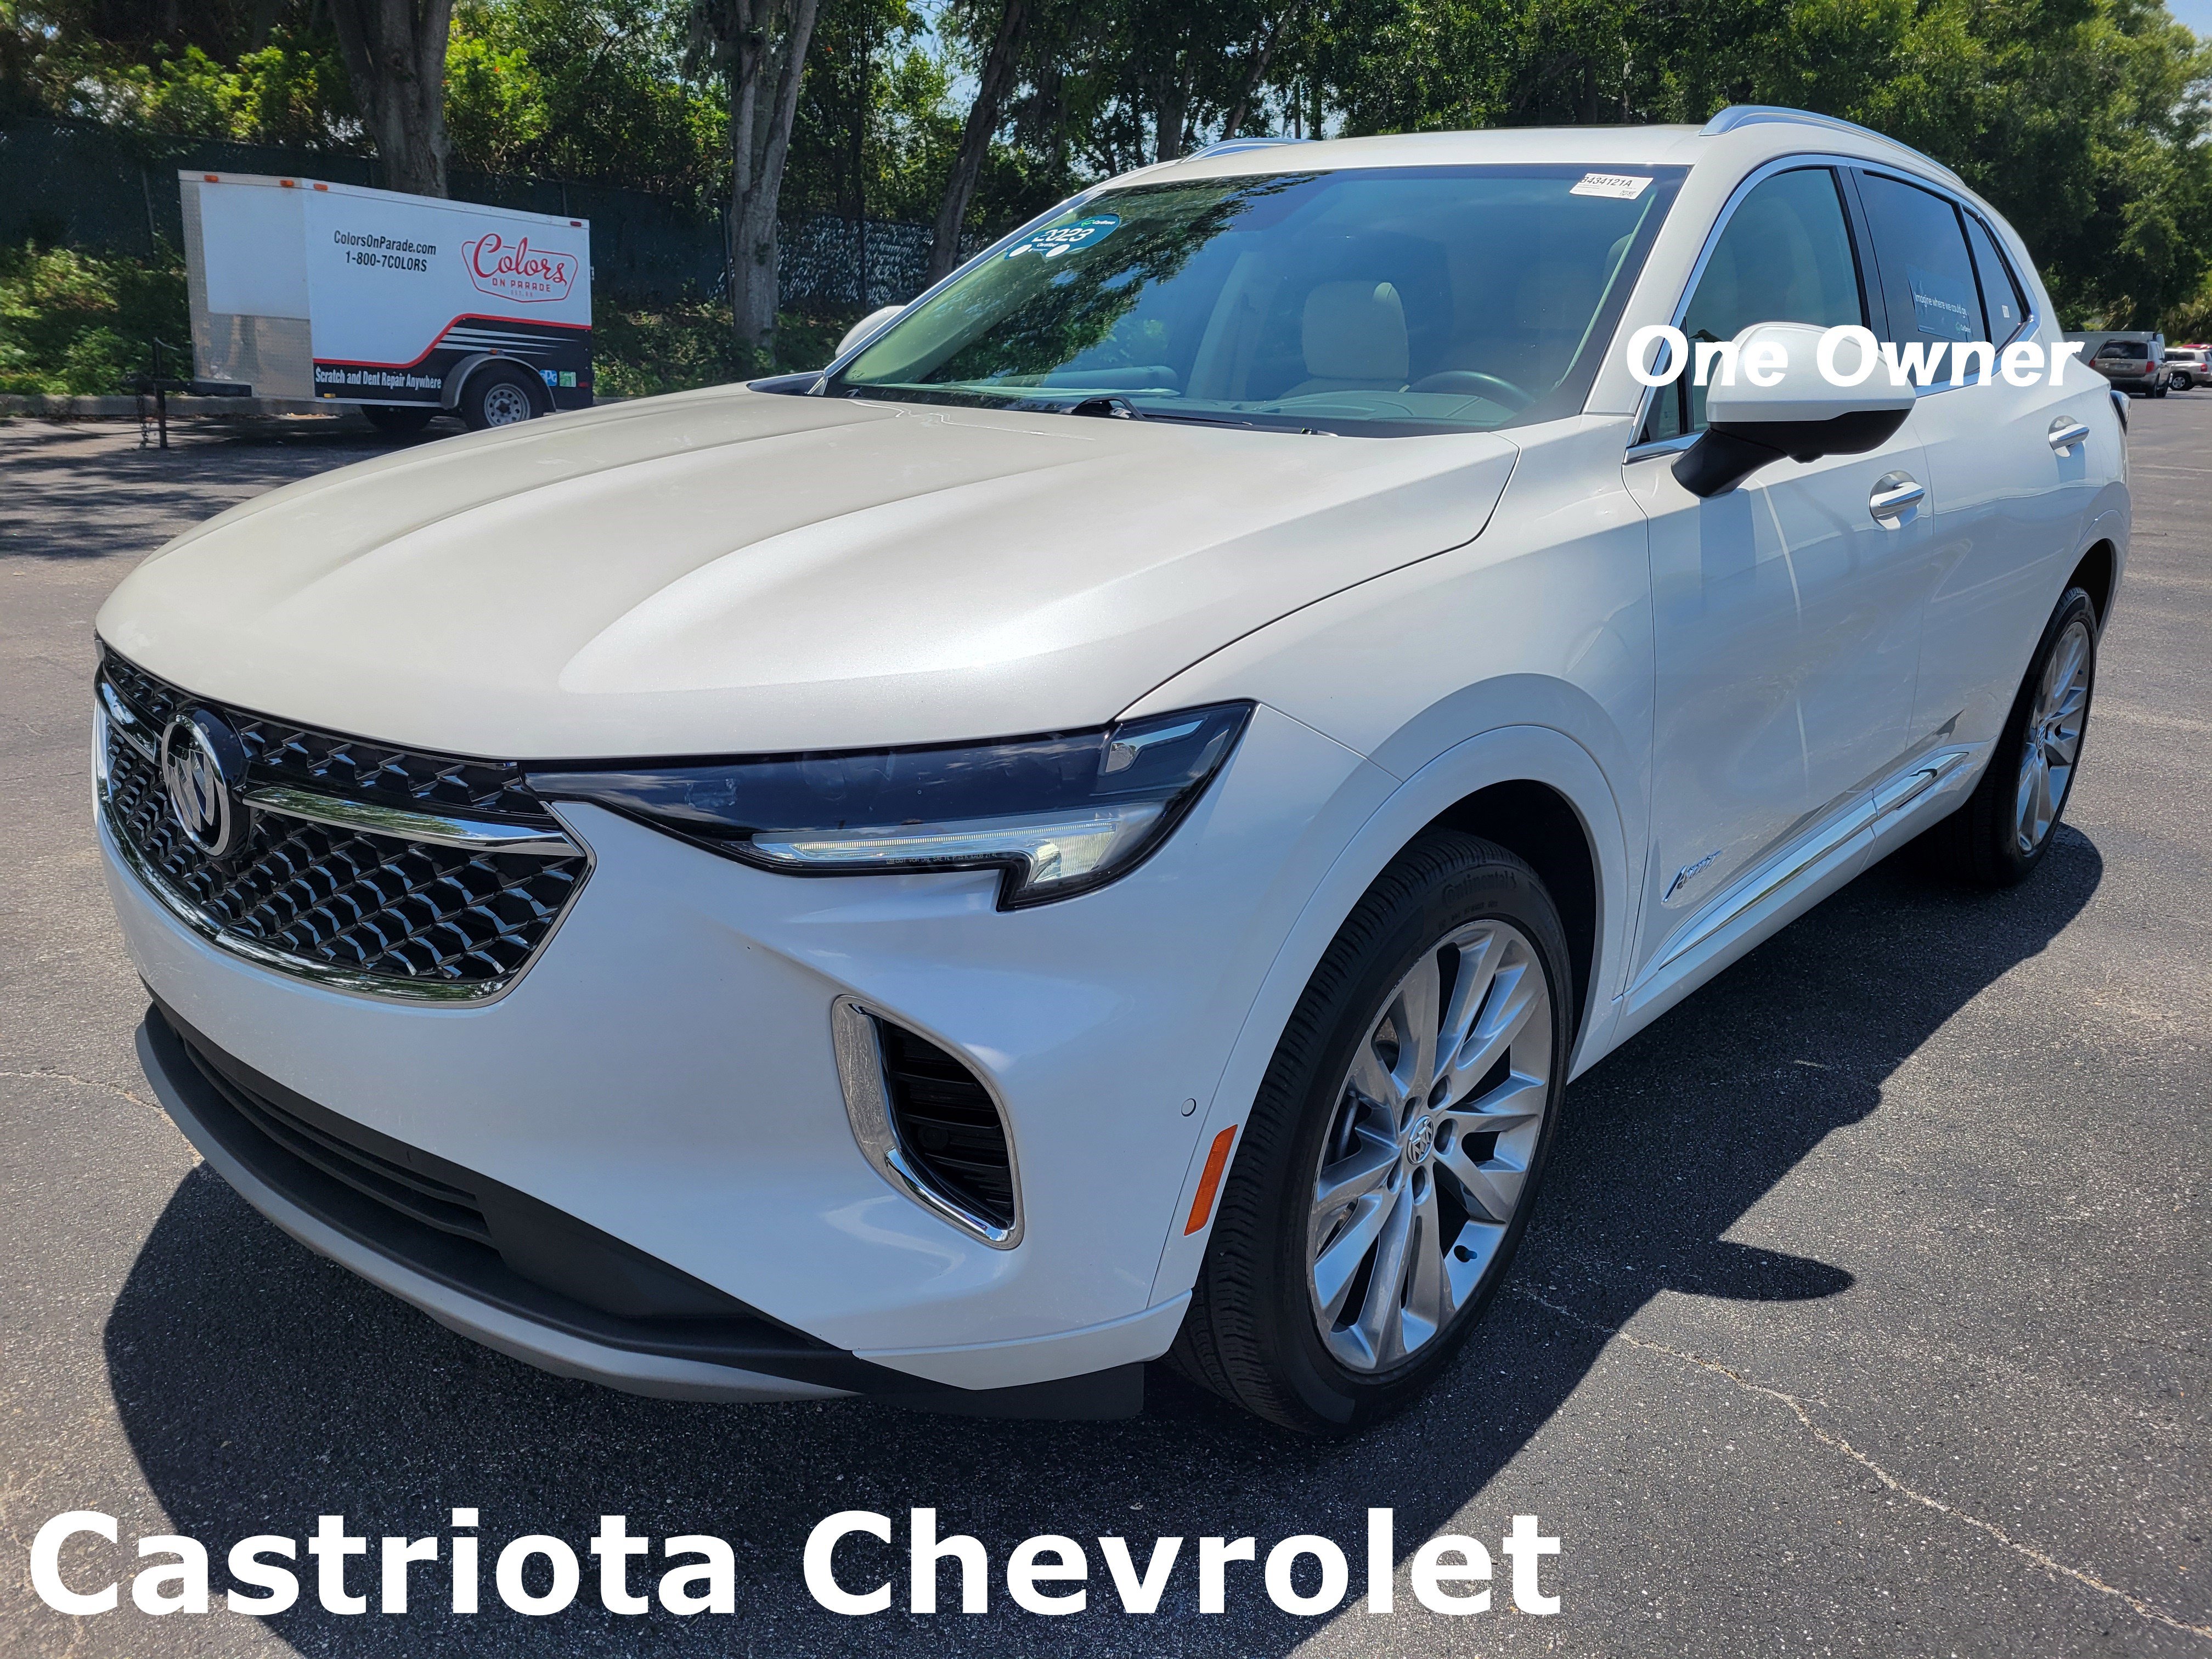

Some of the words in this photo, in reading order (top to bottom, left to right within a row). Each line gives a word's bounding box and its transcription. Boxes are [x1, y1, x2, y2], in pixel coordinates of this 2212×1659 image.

[334, 230, 437, 255] ColorsOnParade.com
[1031, 228, 1096, 242] 2023
[346, 250, 427, 272] 1-800-7COLORS
[473, 233, 568, 287] Colors
[492, 278, 506, 287] ON
[511, 280, 551, 292] PARADE
[1932, 297, 1945, 309] where
[315, 366, 345, 383] Scratch
[347, 370, 362, 385] and
[363, 370, 380, 386] Dent
[381, 371, 405, 390] Repair
[405, 374, 442, 391] Anywhere
